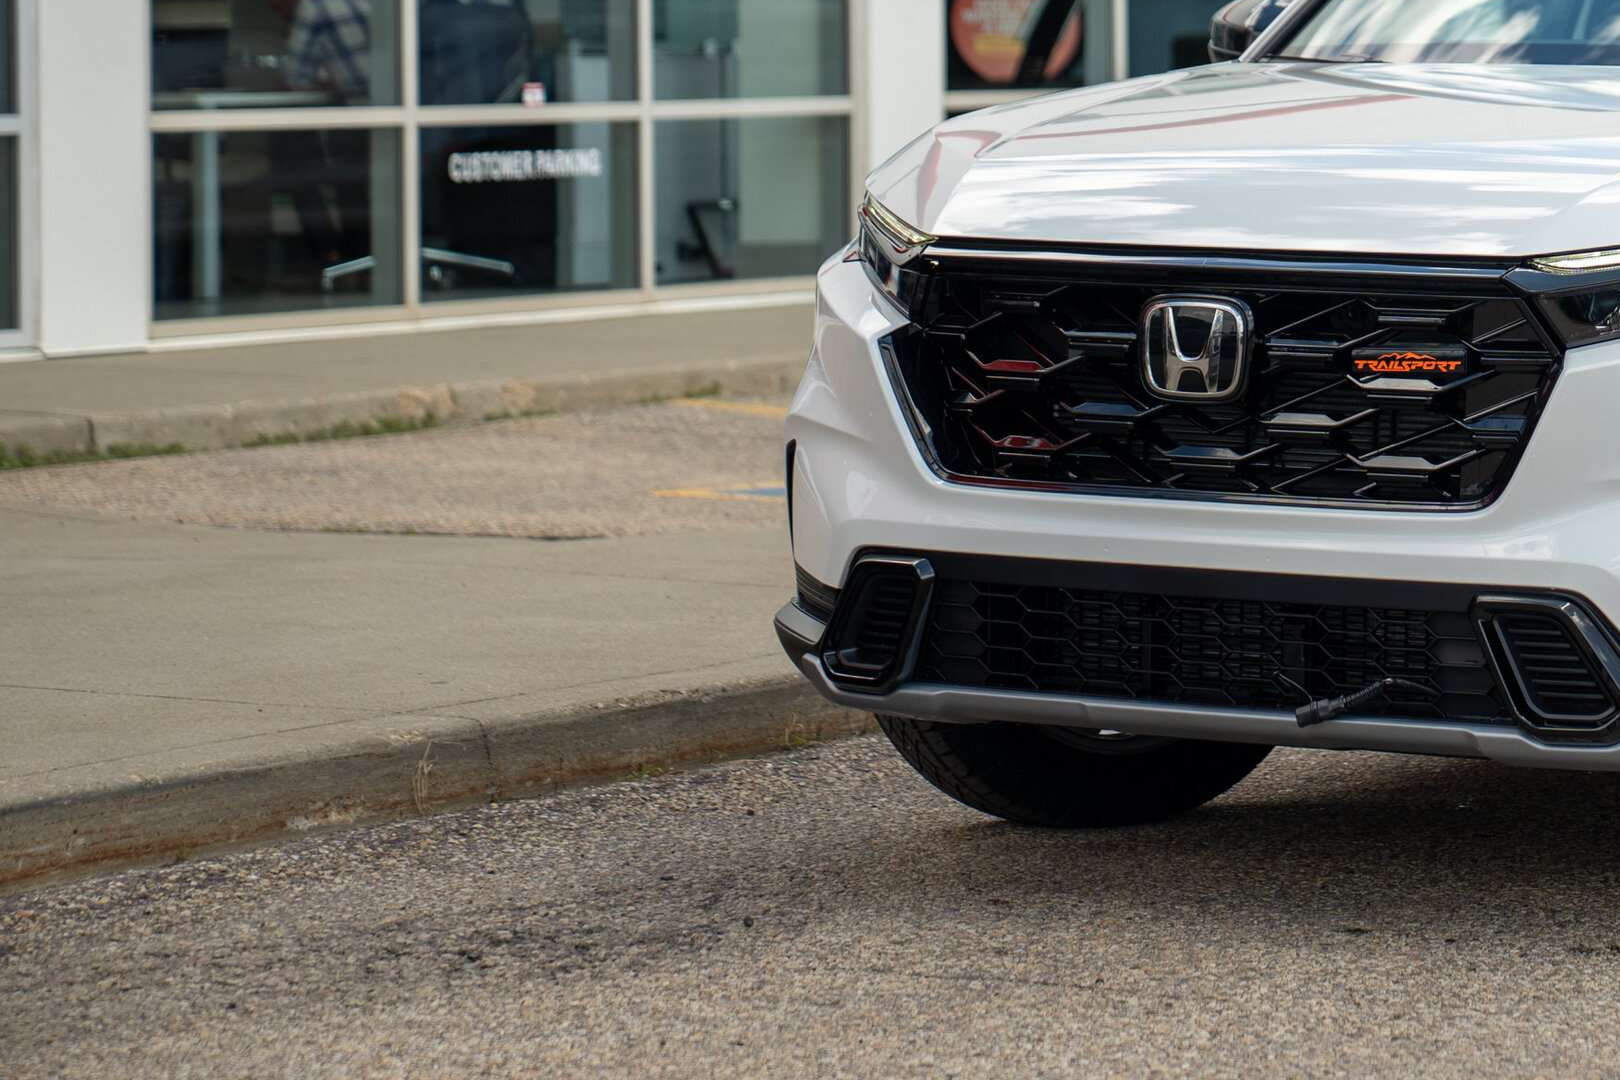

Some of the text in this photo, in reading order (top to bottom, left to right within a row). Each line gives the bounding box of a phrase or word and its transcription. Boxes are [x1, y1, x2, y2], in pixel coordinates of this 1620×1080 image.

[448, 148, 602, 183] CUSTOMER PARKING
[1353, 359, 1462, 373] TRAILSPORT
